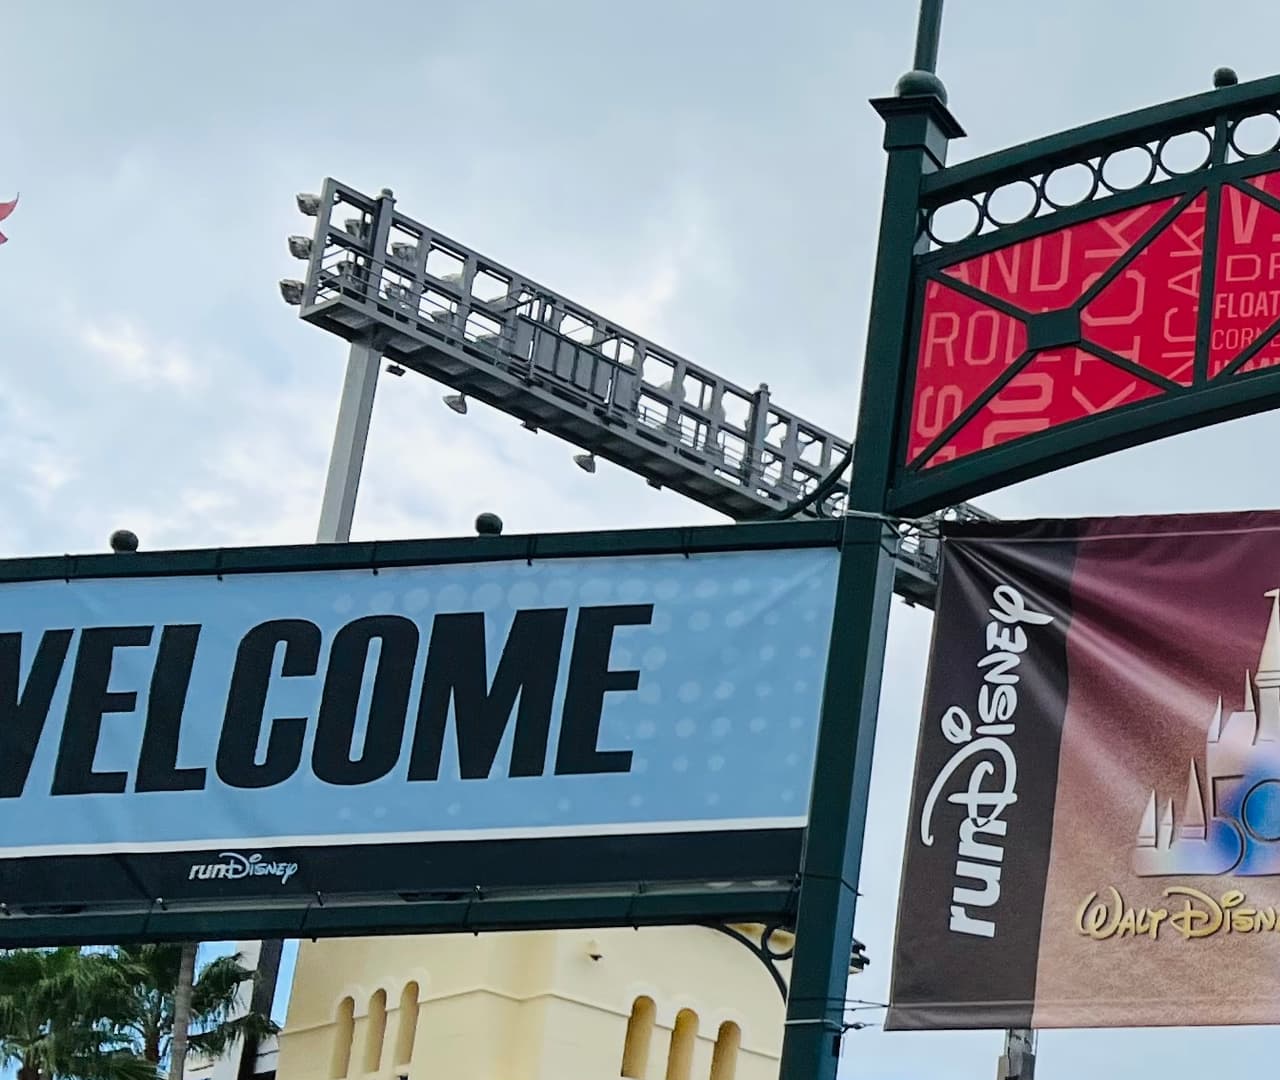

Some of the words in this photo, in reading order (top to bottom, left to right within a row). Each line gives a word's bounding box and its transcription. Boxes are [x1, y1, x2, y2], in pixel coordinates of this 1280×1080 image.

[920, 583, 1055, 938] runDisney
[188, 852, 300, 886] runDisney
[1075, 886, 1167, 941] Walt
